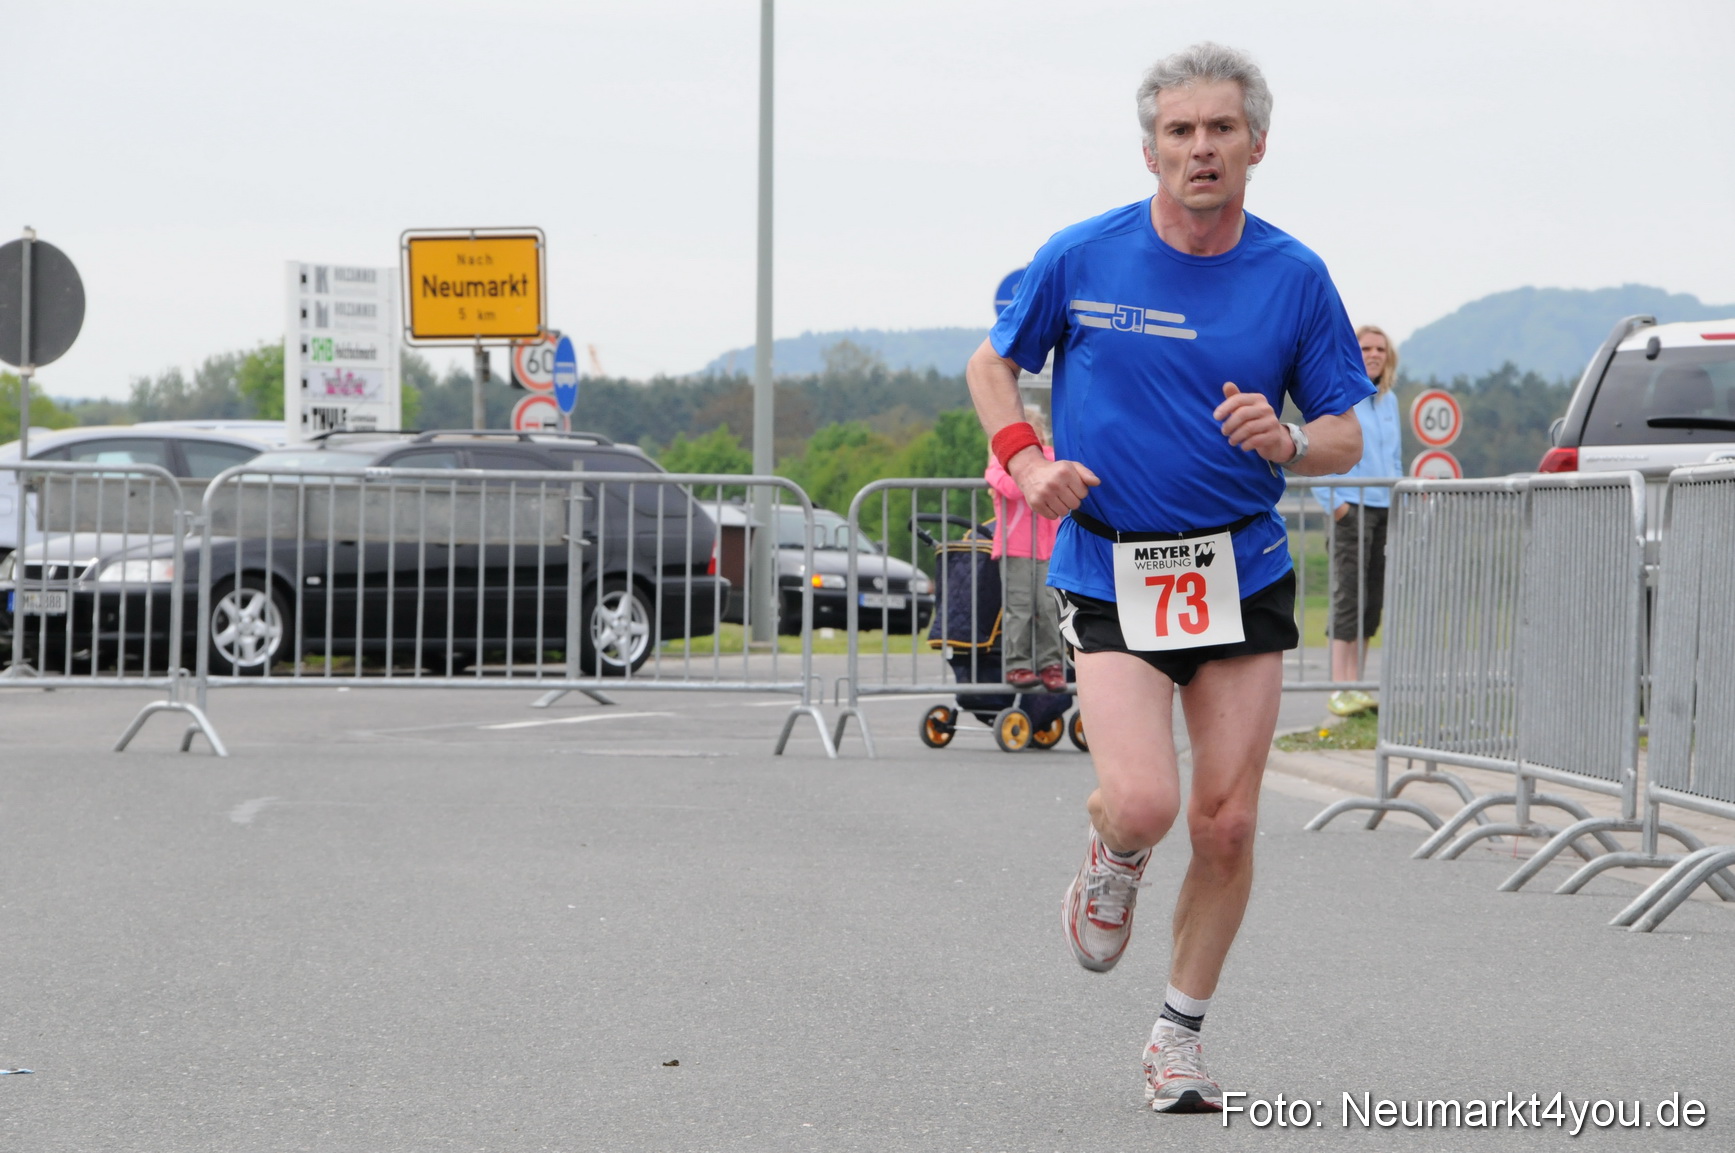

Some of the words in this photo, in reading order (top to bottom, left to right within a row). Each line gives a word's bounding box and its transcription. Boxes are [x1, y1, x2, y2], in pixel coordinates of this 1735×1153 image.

[456, 254, 493, 265] Nach
[422, 273, 529, 297] Neumarkt
[458, 308, 466, 320] 5
[477, 309, 496, 320] km
[527, 348, 554, 374] 60
[1425, 407, 1450, 431] 60
[1134, 545, 1190, 561] MEYER
[1134, 558, 1191, 571] WERBUNG
[1145, 572, 1210, 637] 73
